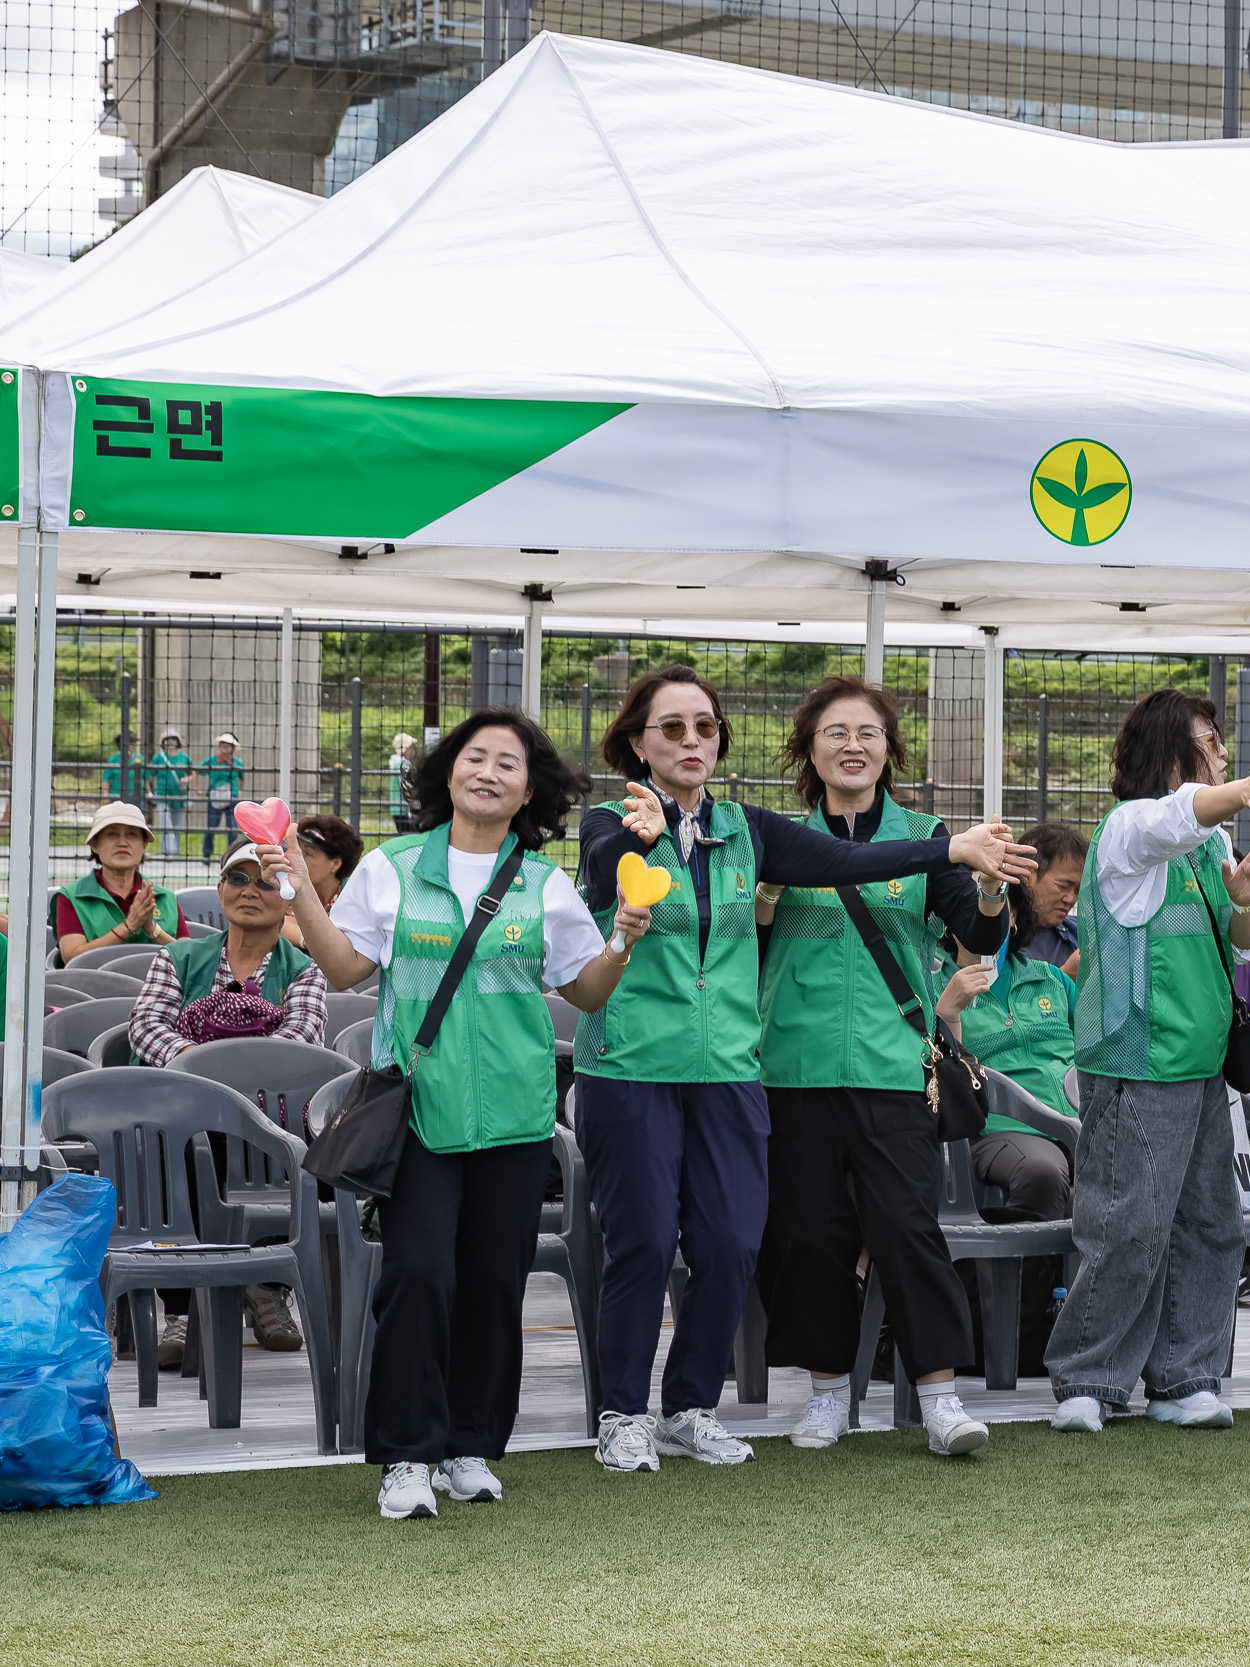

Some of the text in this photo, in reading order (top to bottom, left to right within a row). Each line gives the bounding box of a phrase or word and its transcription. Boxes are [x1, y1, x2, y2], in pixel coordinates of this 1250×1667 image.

[93, 394, 223, 462] 근면
[883, 896, 905, 906] SMU
[500, 944, 525, 953] SMU
